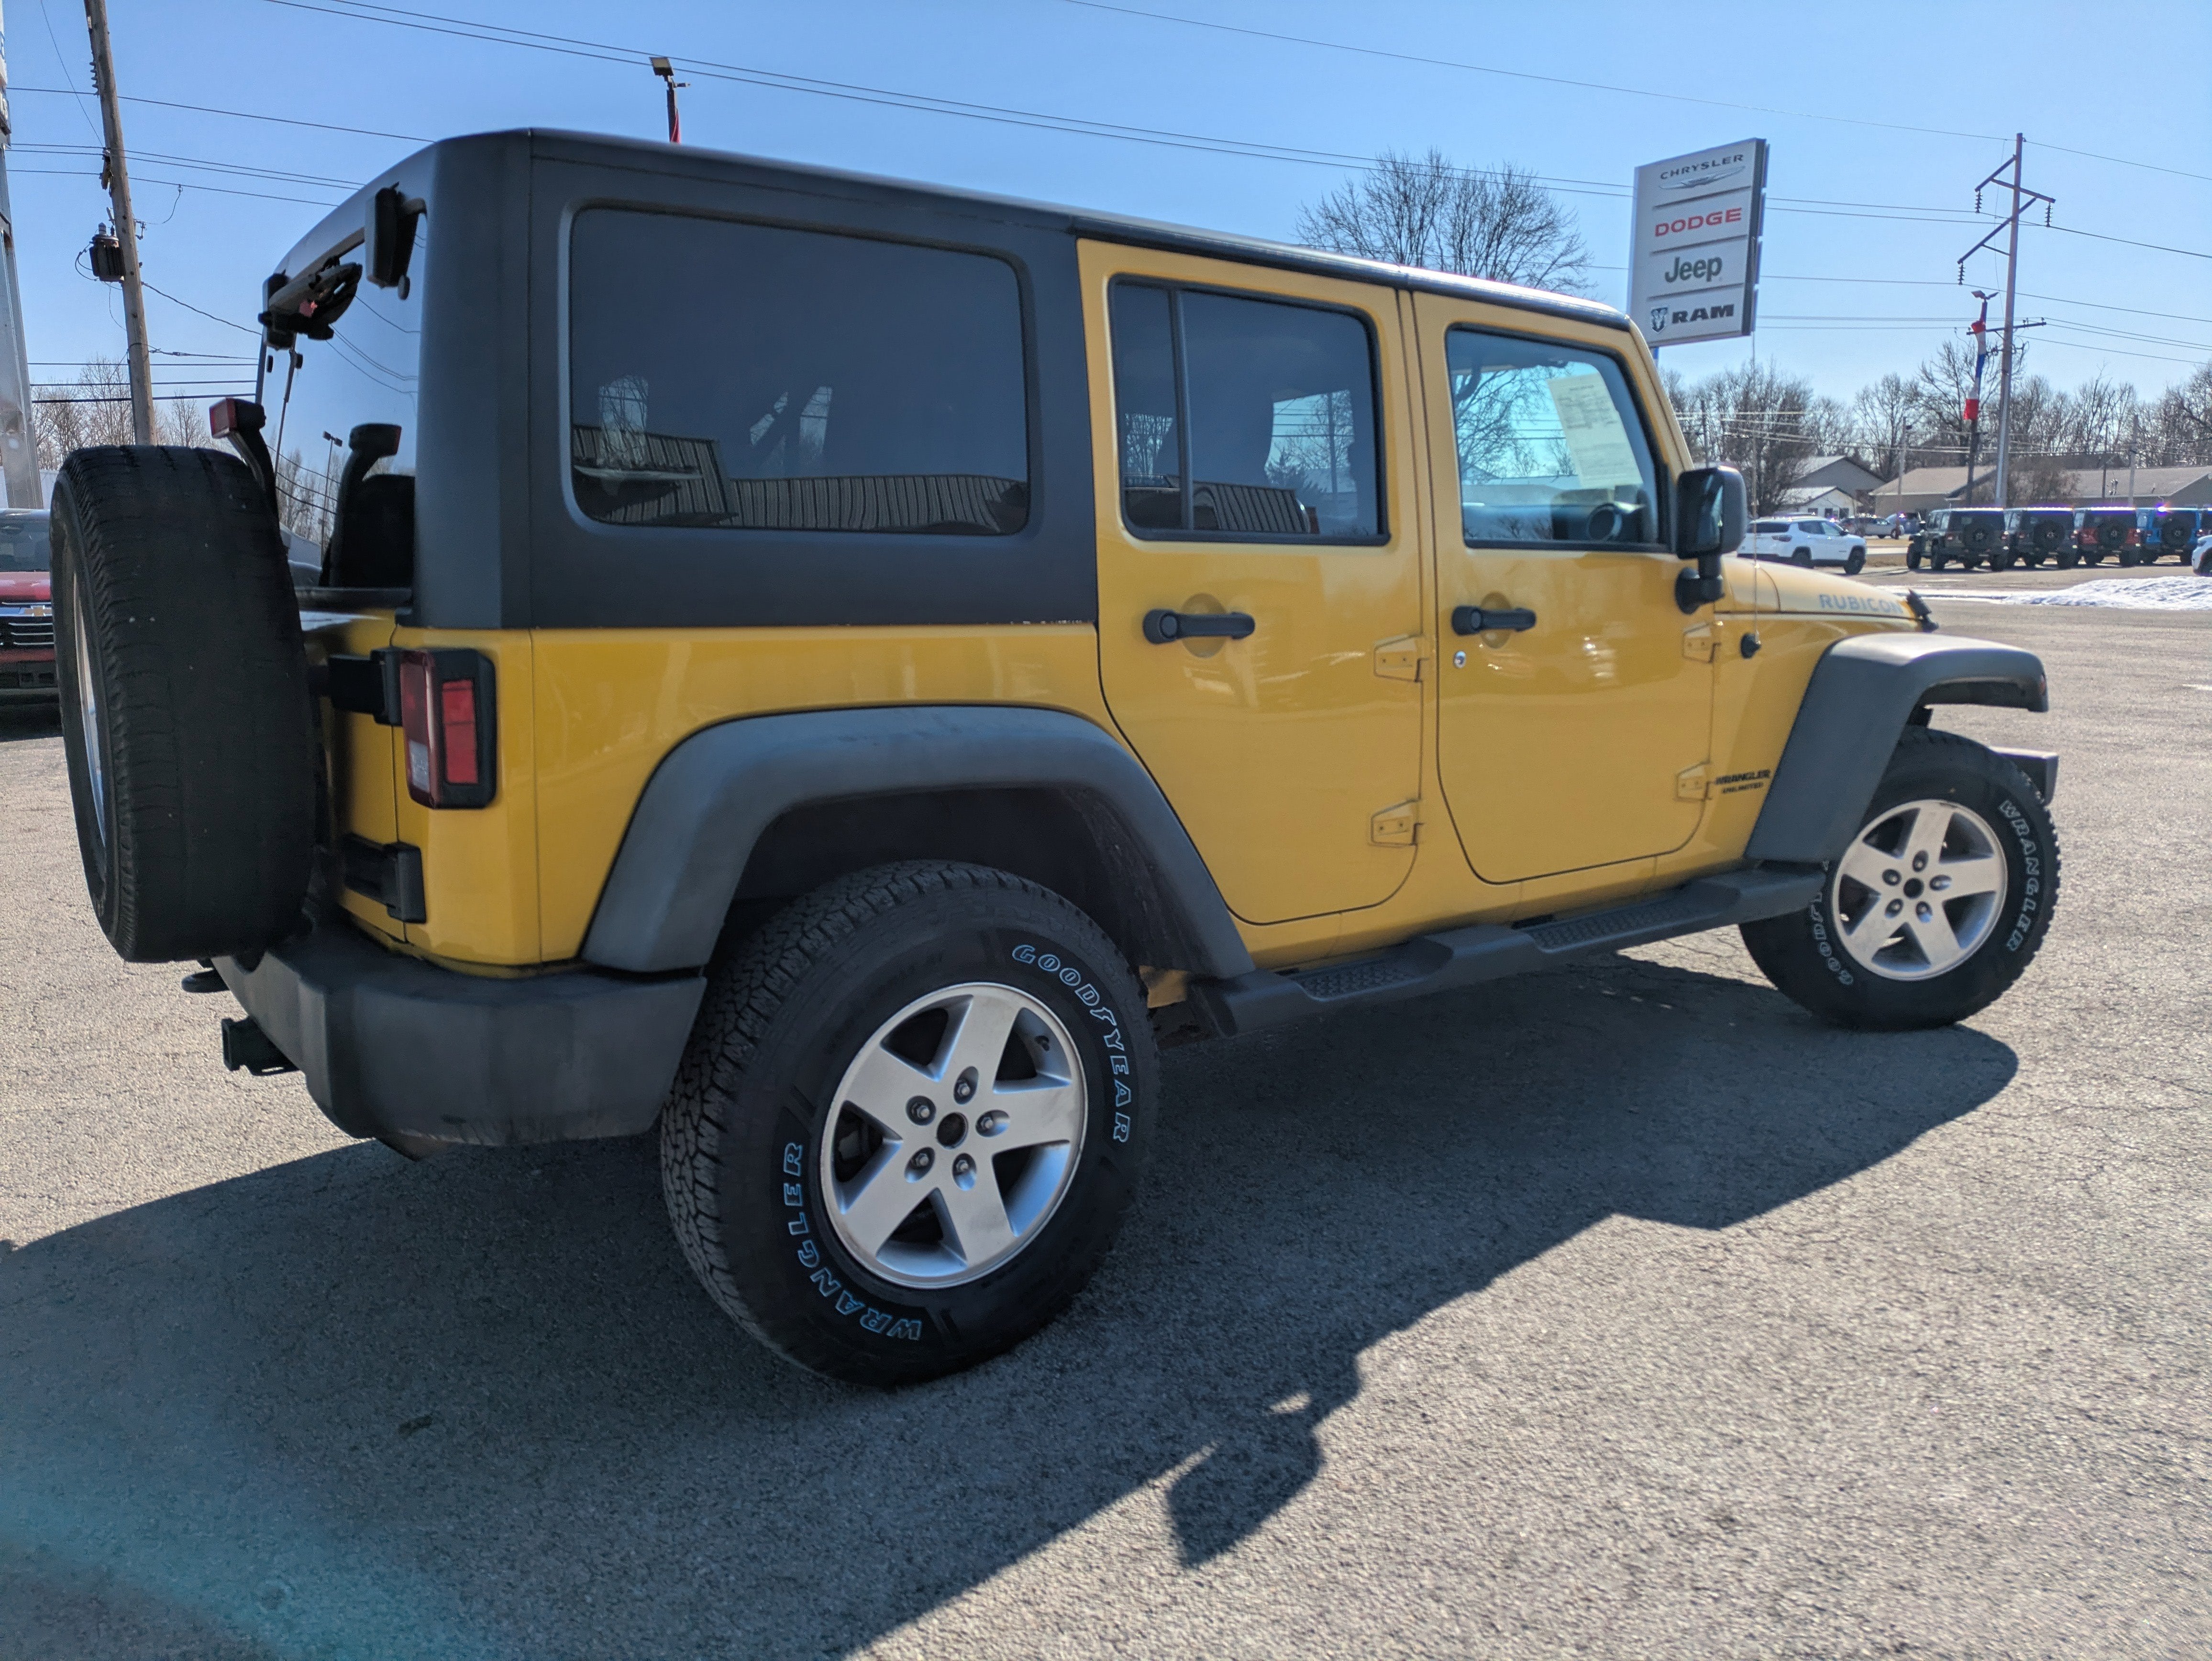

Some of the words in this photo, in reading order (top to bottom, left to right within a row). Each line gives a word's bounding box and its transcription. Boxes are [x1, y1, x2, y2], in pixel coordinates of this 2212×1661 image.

[1660, 154, 1744, 180] CHRYSLER
[1655, 208, 1742, 237] DODGE
[1665, 256, 1722, 283] Jeep
[1671, 304, 1735, 324] RAM
[1819, 593, 1903, 613] RUBICON
[1998, 800, 2039, 952] WRANGLER
[1012, 944, 1132, 1143] GOODYEAR
[783, 1142, 922, 1340] WRANGLER
